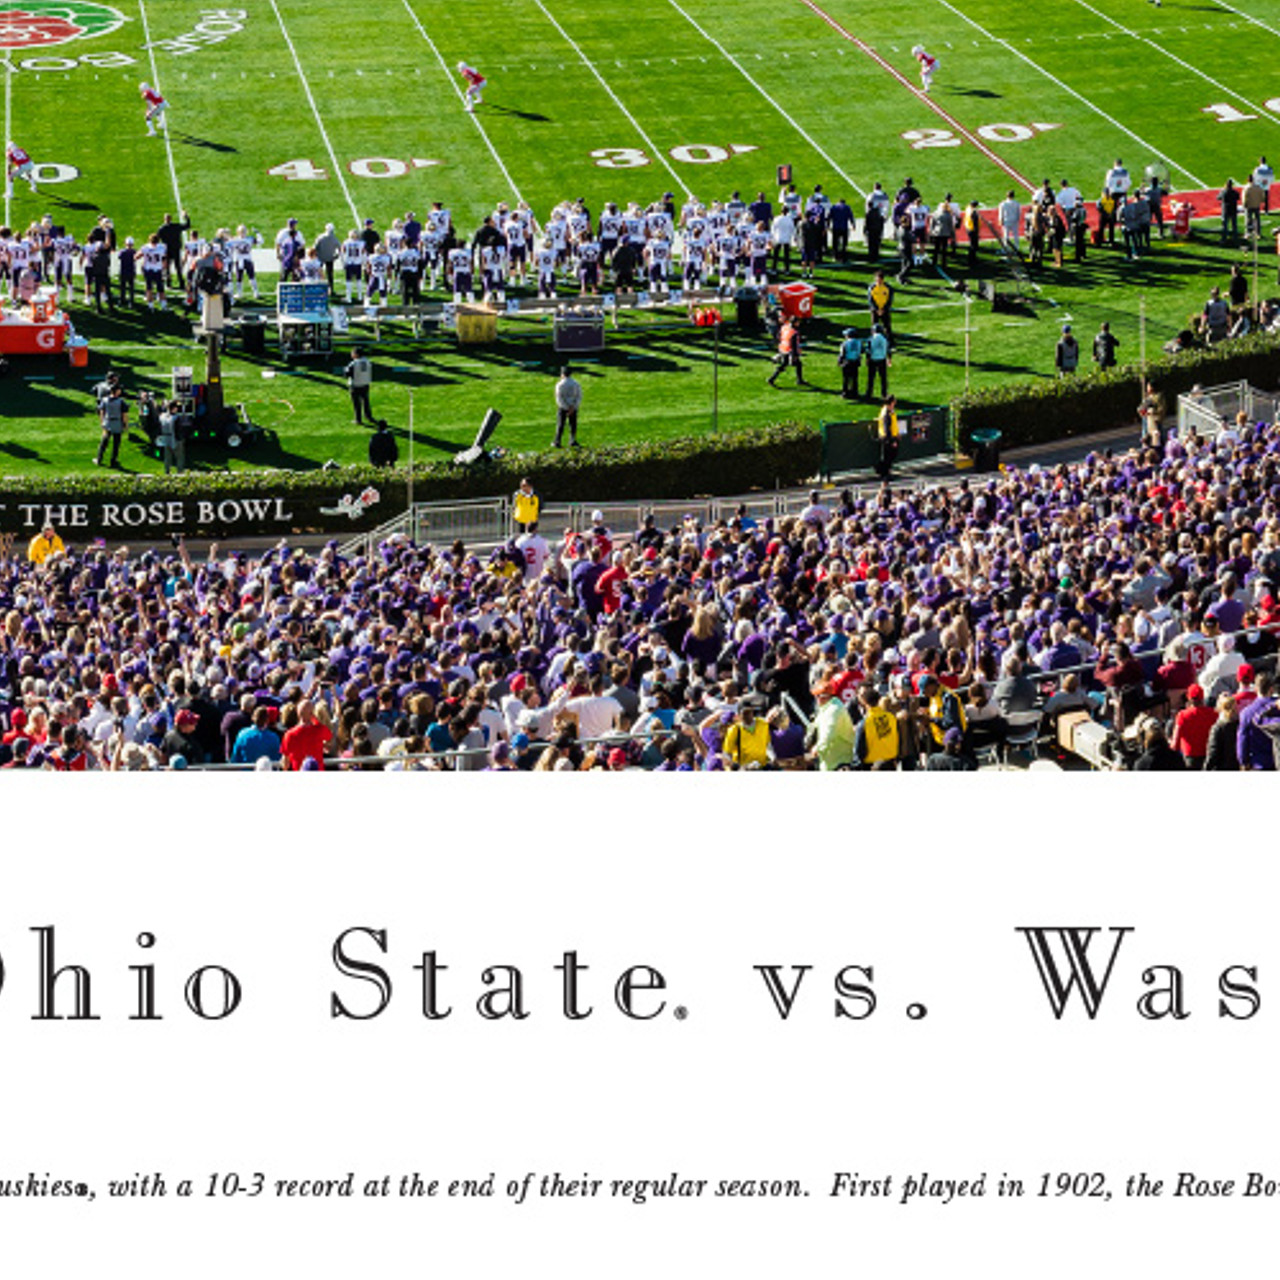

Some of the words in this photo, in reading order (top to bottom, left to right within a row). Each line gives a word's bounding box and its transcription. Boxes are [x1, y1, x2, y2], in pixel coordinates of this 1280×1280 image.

[901, 121, 1036, 150] 20
[267, 156, 412, 180] 40
[589, 143, 732, 169] 30
[36, 328, 55, 348] G
[18, 504, 89, 526] THE
[102, 501, 185, 526] ROSE
[196, 498, 294, 523] BOWL
